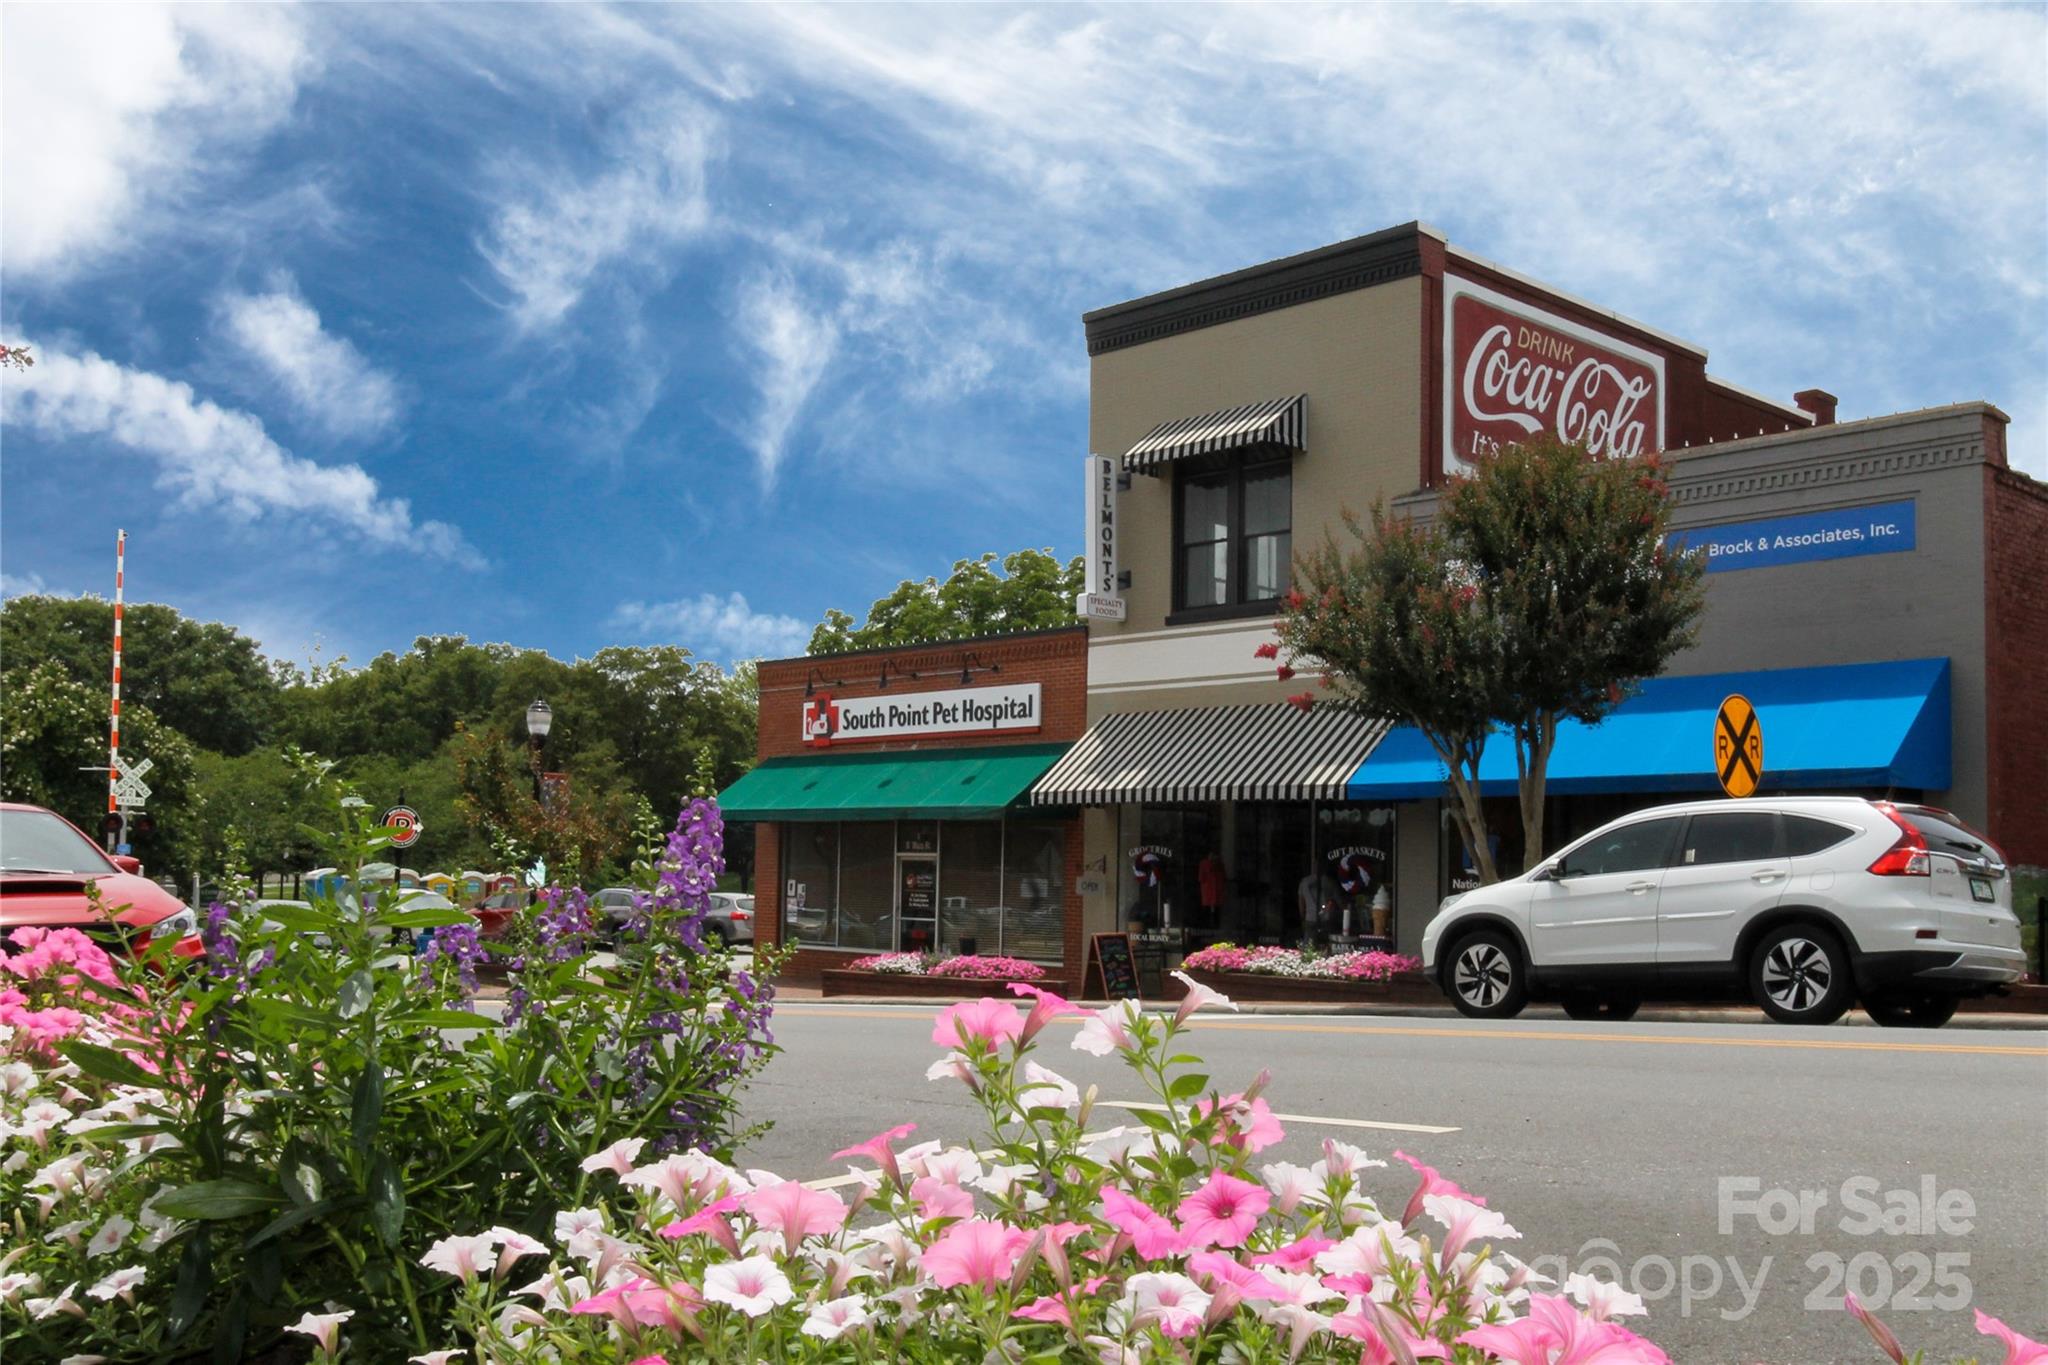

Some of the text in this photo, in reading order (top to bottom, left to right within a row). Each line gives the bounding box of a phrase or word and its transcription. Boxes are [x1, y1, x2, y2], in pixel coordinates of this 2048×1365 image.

[1517, 326, 1575, 365] DRINK
[1463, 325, 1652, 460] Coca-Cola
[1101, 460, 1114, 592] BELMONT'S
[1709, 539, 1753, 557] Brock
[1757, 537, 1769, 551] &
[1773, 527, 1865, 550] Associates,
[1869, 523, 1900, 538] Inc.
[1090, 597, 1123, 608] SPECIALTY
[1095, 606, 1118, 617] FOODS
[842, 694, 1033, 731] South Point Pet Hospital
[1718, 735, 1760, 760] R R
[1128, 845, 1173, 858] GROCERIES
[1327, 846, 1386, 860] GIFT BASKETS
[1452, 878, 1481, 889] Natio
[1130, 932, 1169, 942] LOCAL HONEY
